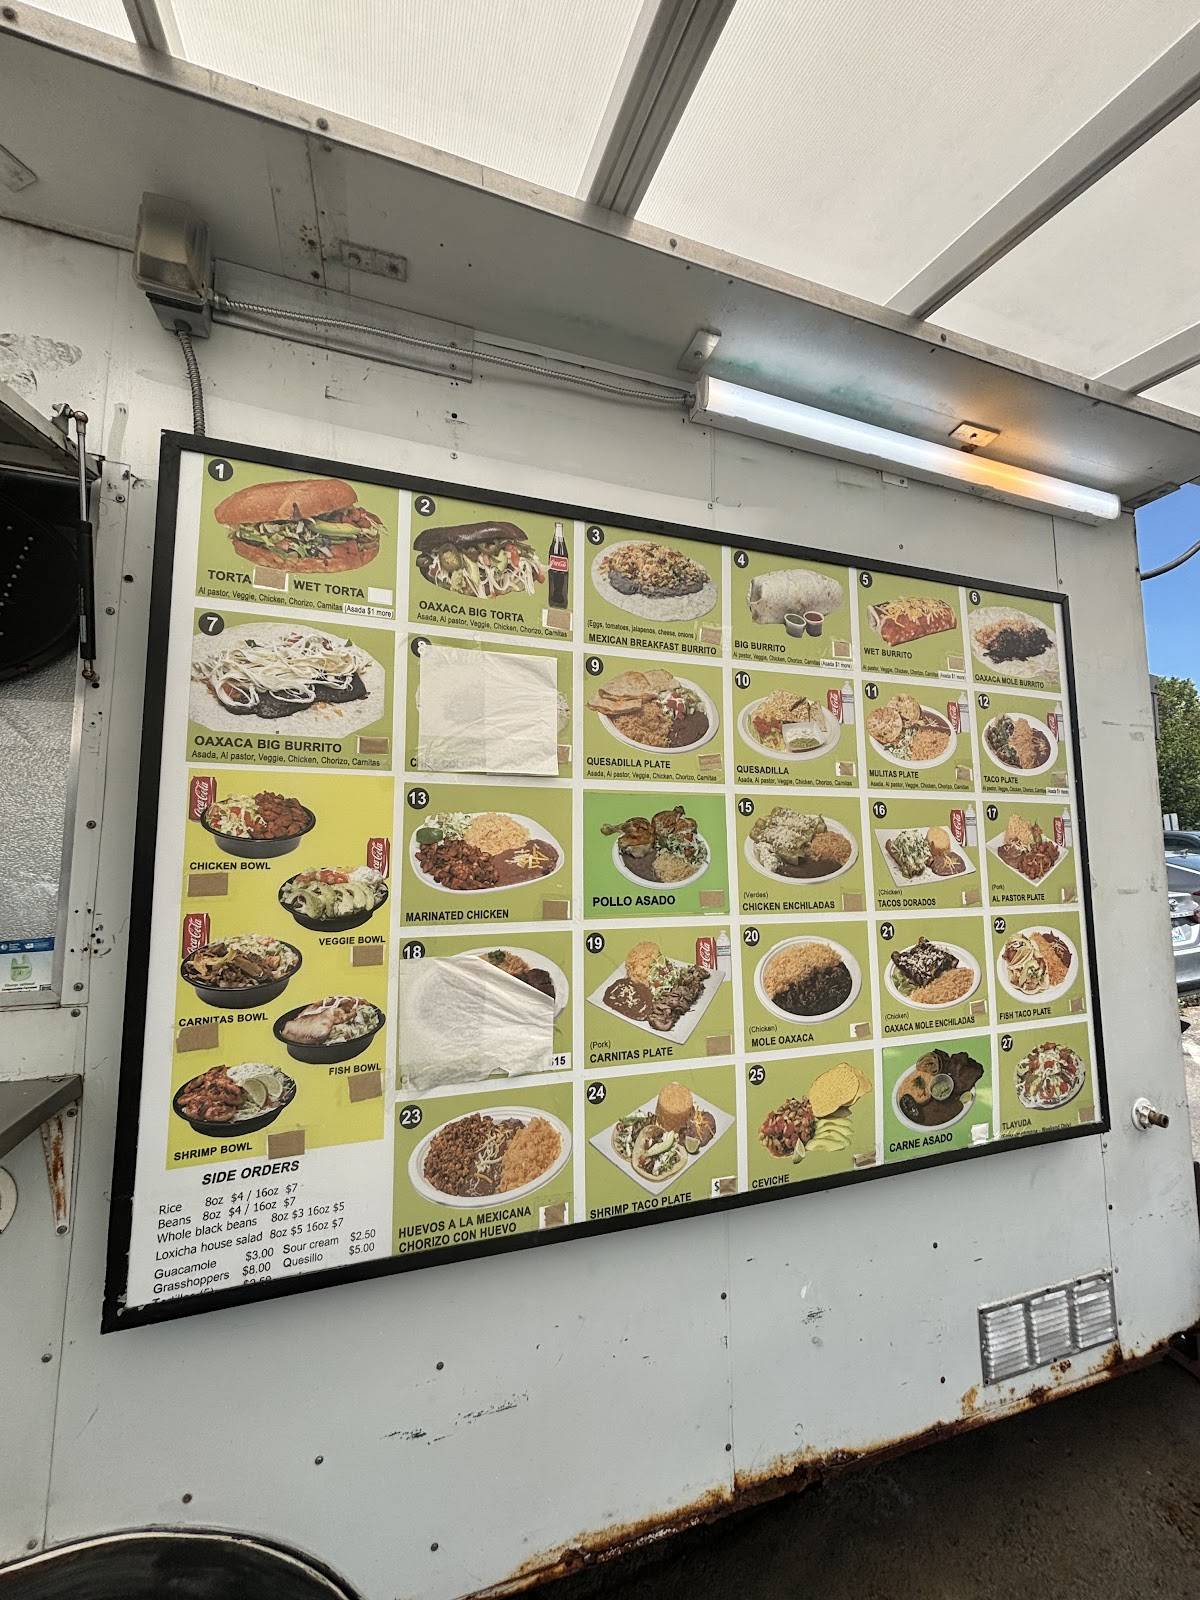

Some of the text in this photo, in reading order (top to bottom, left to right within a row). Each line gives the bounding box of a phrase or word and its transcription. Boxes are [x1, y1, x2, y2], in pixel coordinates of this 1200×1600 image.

[215, 462, 224, 480] 1
[420, 499, 430, 512] 2
[591, 529, 600, 542] 3
[737, 553, 745, 565] 4
[207, 570, 252, 586] TORTA
[862, 574, 868, 585] 5
[293, 580, 366, 600] WET TORTA
[207, 587, 230, 599] pastor,
[232, 590, 257, 602] Veggie,
[258, 594, 287, 604] Chicken,
[288, 597, 315, 608] Chorizo,
[316, 601, 342, 611] Carnitas
[972, 592, 977, 602] 6
[344, 602, 393, 619] (Asada $1 more)
[419, 600, 524, 623] OAXACA BIG TORTA
[207, 616, 219, 632] 7
[589, 633, 717, 655] MEXICAN BREAKFAST BURRITO
[734, 640, 785, 653] BIG BURRITO
[863, 647, 912, 659] WET BURRITO
[591, 659, 599, 672] 9
[735, 673, 749, 688] 10
[974, 673, 1001, 683] OAXACA
[1001, 677, 1018, 686] MOLE
[1019, 679, 1044, 688] BURRITO
[865, 685, 877, 697] 11
[978, 696, 988, 706] 12
[194, 735, 342, 753] OAXACA BIG BURRITO
[191, 750, 381, 768] Asada, Al pastor, Veggie, Chicken, Chorizo, Carnitas
[586, 756, 671, 769] QUESADILLA PLATE
[736, 764, 790, 775] QUESADILLA
[869, 769, 919, 779] MULITAS PLATE
[983, 775, 1018, 784] TACO PLATE
[409, 792, 427, 805] 13
[738, 801, 752, 813] 15
[873, 804, 886, 815] 16
[987, 807, 997, 818] 17
[189, 861, 271, 870] CHICKEN BOWL
[592, 895, 675, 907] POLLO ASADO
[878, 898, 936, 908] TACOS DORADOS
[1001, 894, 1026, 902] PASTOR
[1026, 893, 1045, 901] PLATE
[742, 901, 835, 911] CHICKEN ENCHILADAS
[405, 909, 509, 922] MARINATED CHICKEN
[881, 925, 893, 937] 21
[995, 920, 1005, 930] 22
[318, 935, 386, 948] VEGGIE BOWL
[744, 930, 758, 943] 20
[586, 937, 602, 950] 19
[403, 945, 421, 959] 18
[178, 1012, 268, 1027] CARNITAS BOWL
[999, 1007, 1051, 1021] FISH TACO PLATE
[884, 1016, 975, 1033] OAXACA MOLE ENCHILADAS
[589, 1040, 610, 1051] (Pork)
[751, 1033, 814, 1047] MOLE OAXACA
[1002, 1037, 1012, 1048] 27
[551, 1056, 566, 1066] 15
[589, 1047, 673, 1064] CARNITAS PLATE
[329, 1063, 382, 1076] FISH BOWL
[749, 1068, 763, 1081] 25
[588, 1085, 604, 1100] 24
[401, 1109, 420, 1126] 23
[1002, 1119, 1032, 1132] TLAYUDA
[889, 1132, 953, 1152] CARNE ASADO
[174, 1142, 253, 1161] SHRIMP BOWL
[201, 1160, 300, 1185] SIDE ORDERS
[752, 1174, 790, 1189] CEVICHE
[159, 1182, 298, 1215] Rice 8oz $4 16oz $7
[157, 1196, 296, 1229] Beans 8oz $4 16oz $7
[590, 1192, 692, 1220] SHRIMP TACO PLATE
[157, 1200, 345, 1244] Whole black beans 8oz $3 16oz $5
[398, 1206, 532, 1239] HUEVOS A LA MEXICANA
[155, 1217, 344, 1262] Loxicha house salad 8oz $5 16oz $7
[398, 1222, 517, 1254] CHORIZO CON HUEVO
[154, 1228, 376, 1280] Guacamole $3.00 Sour cream $2.50
[152, 1270, 230, 1295] Grasshoppers
[242, 1261, 271, 1278] $8.00
[282, 1252, 323, 1270] Quesillo
[348, 1242, 375, 1258] $5.00
